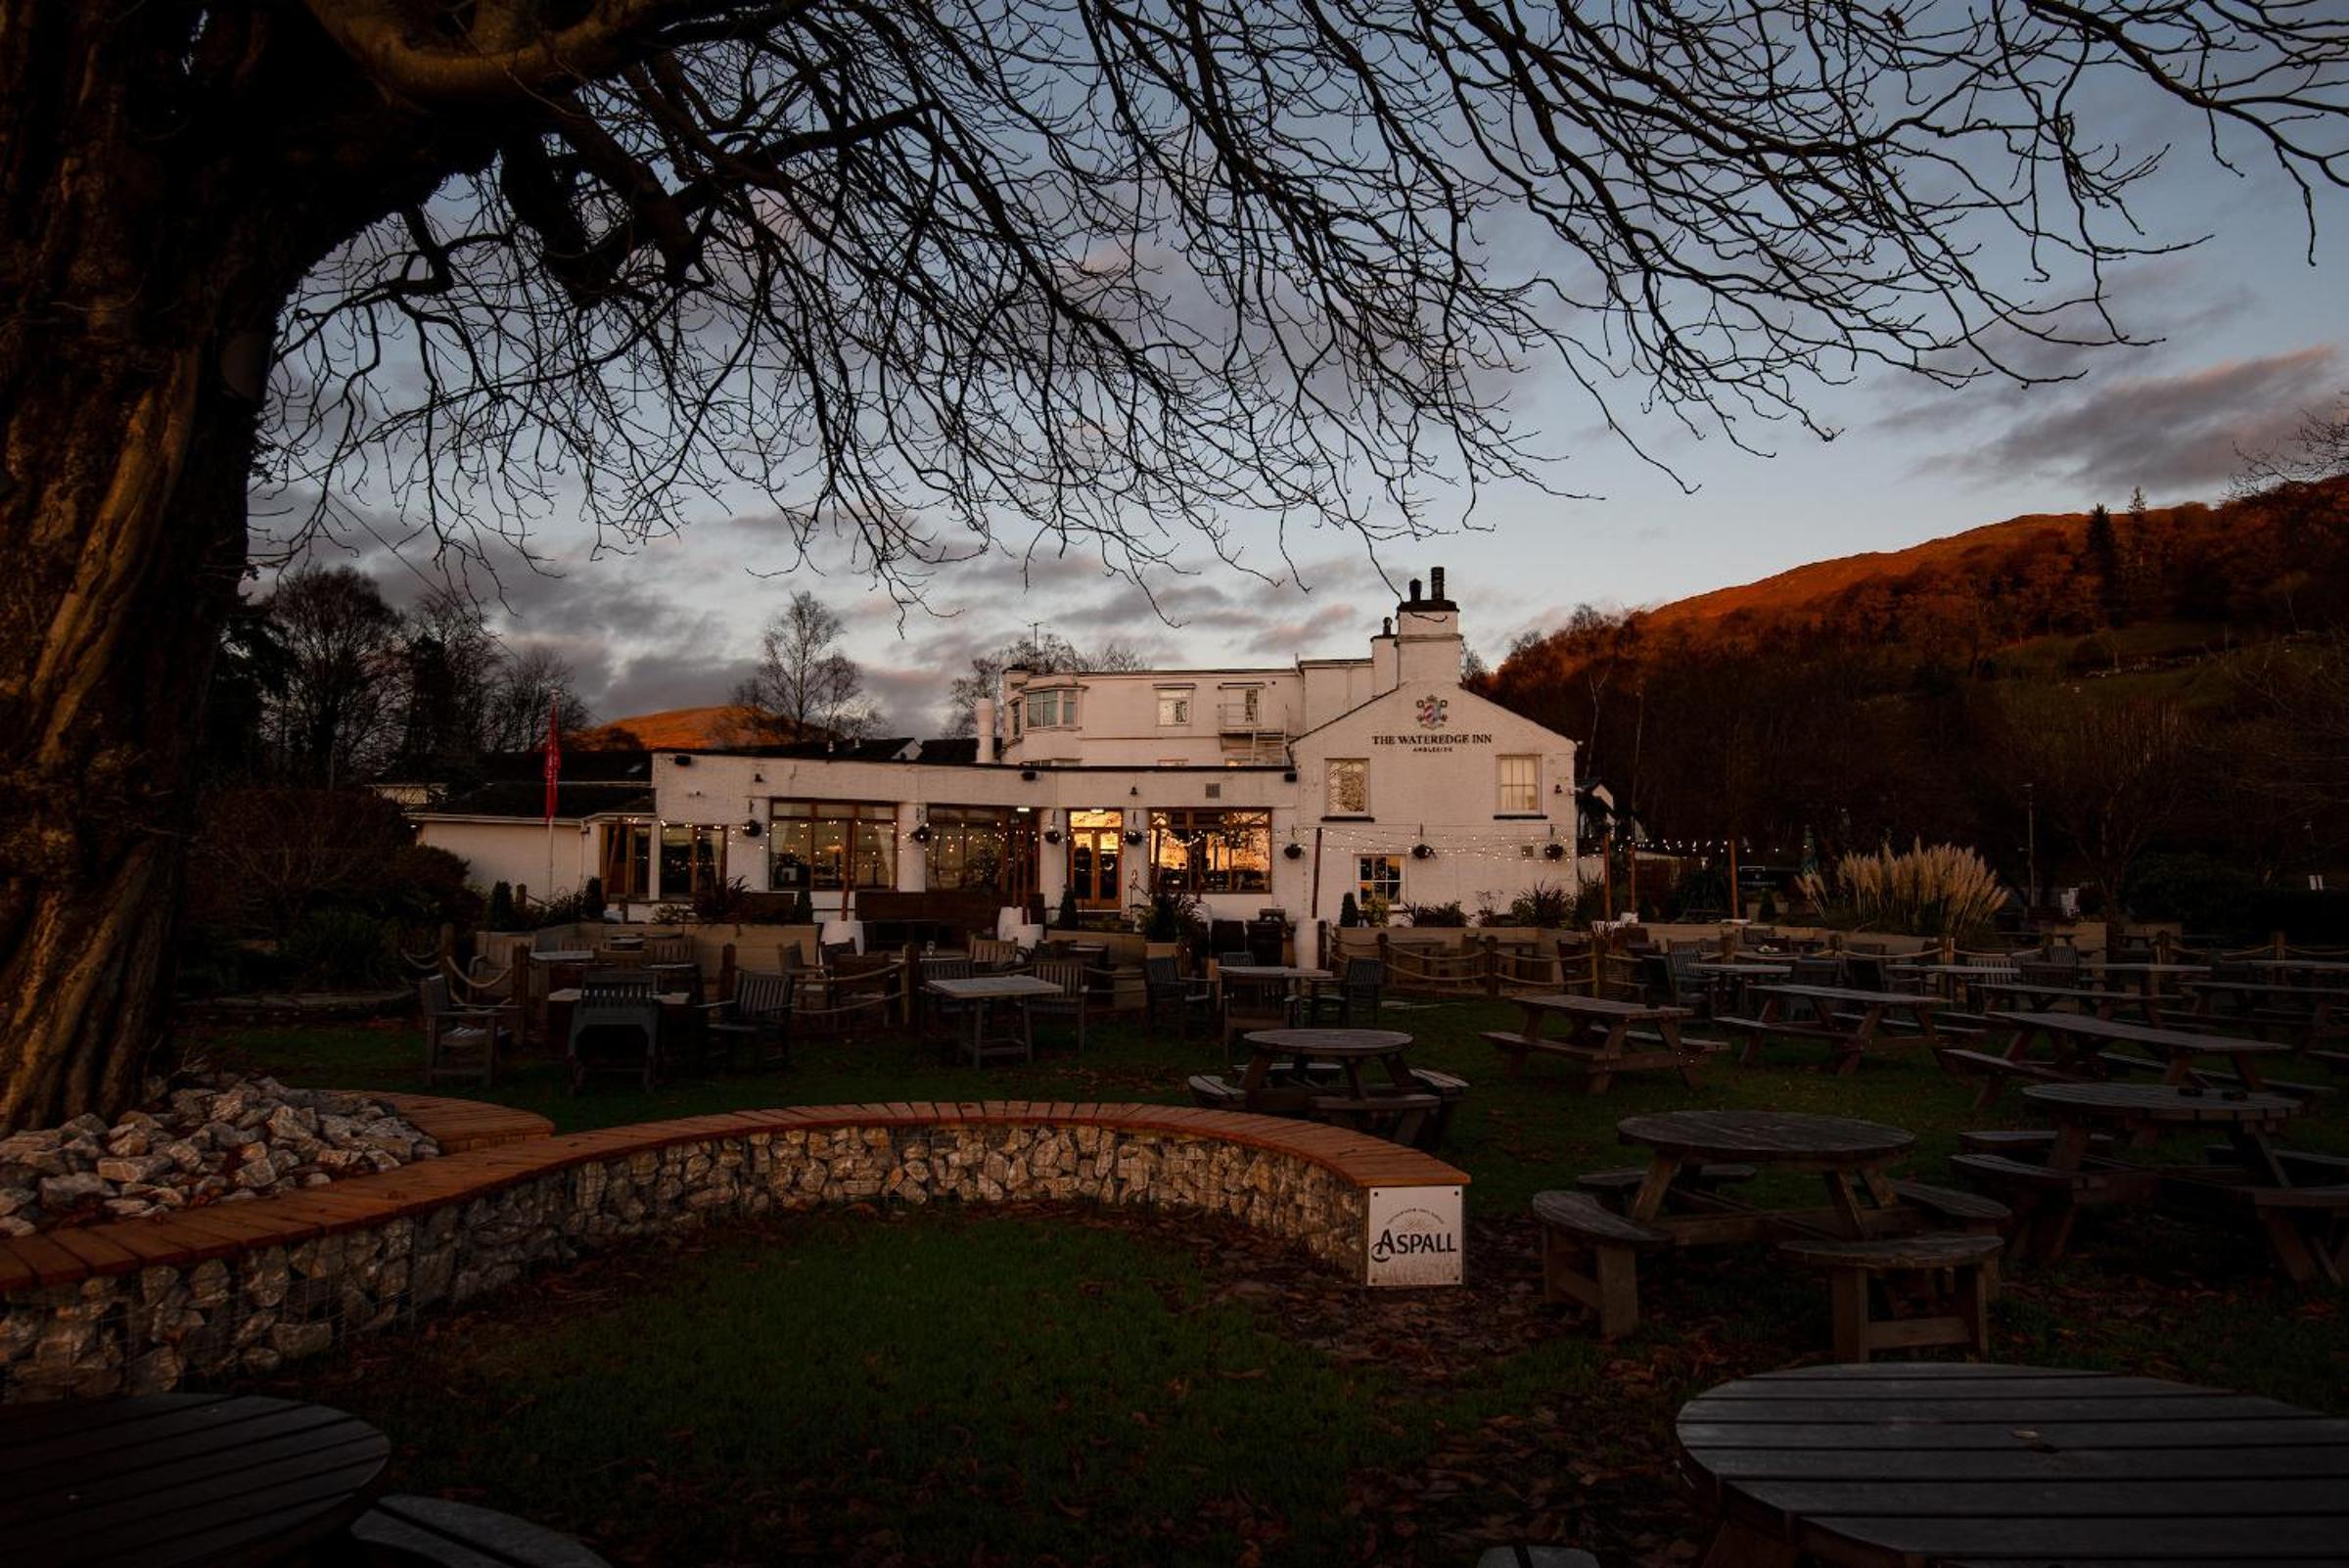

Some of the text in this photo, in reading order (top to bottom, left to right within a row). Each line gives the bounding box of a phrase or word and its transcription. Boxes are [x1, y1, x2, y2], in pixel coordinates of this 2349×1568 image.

[1372, 734, 1493, 745] THE WATEREDGE INN
[1371, 1228, 1457, 1263] ASPALL
